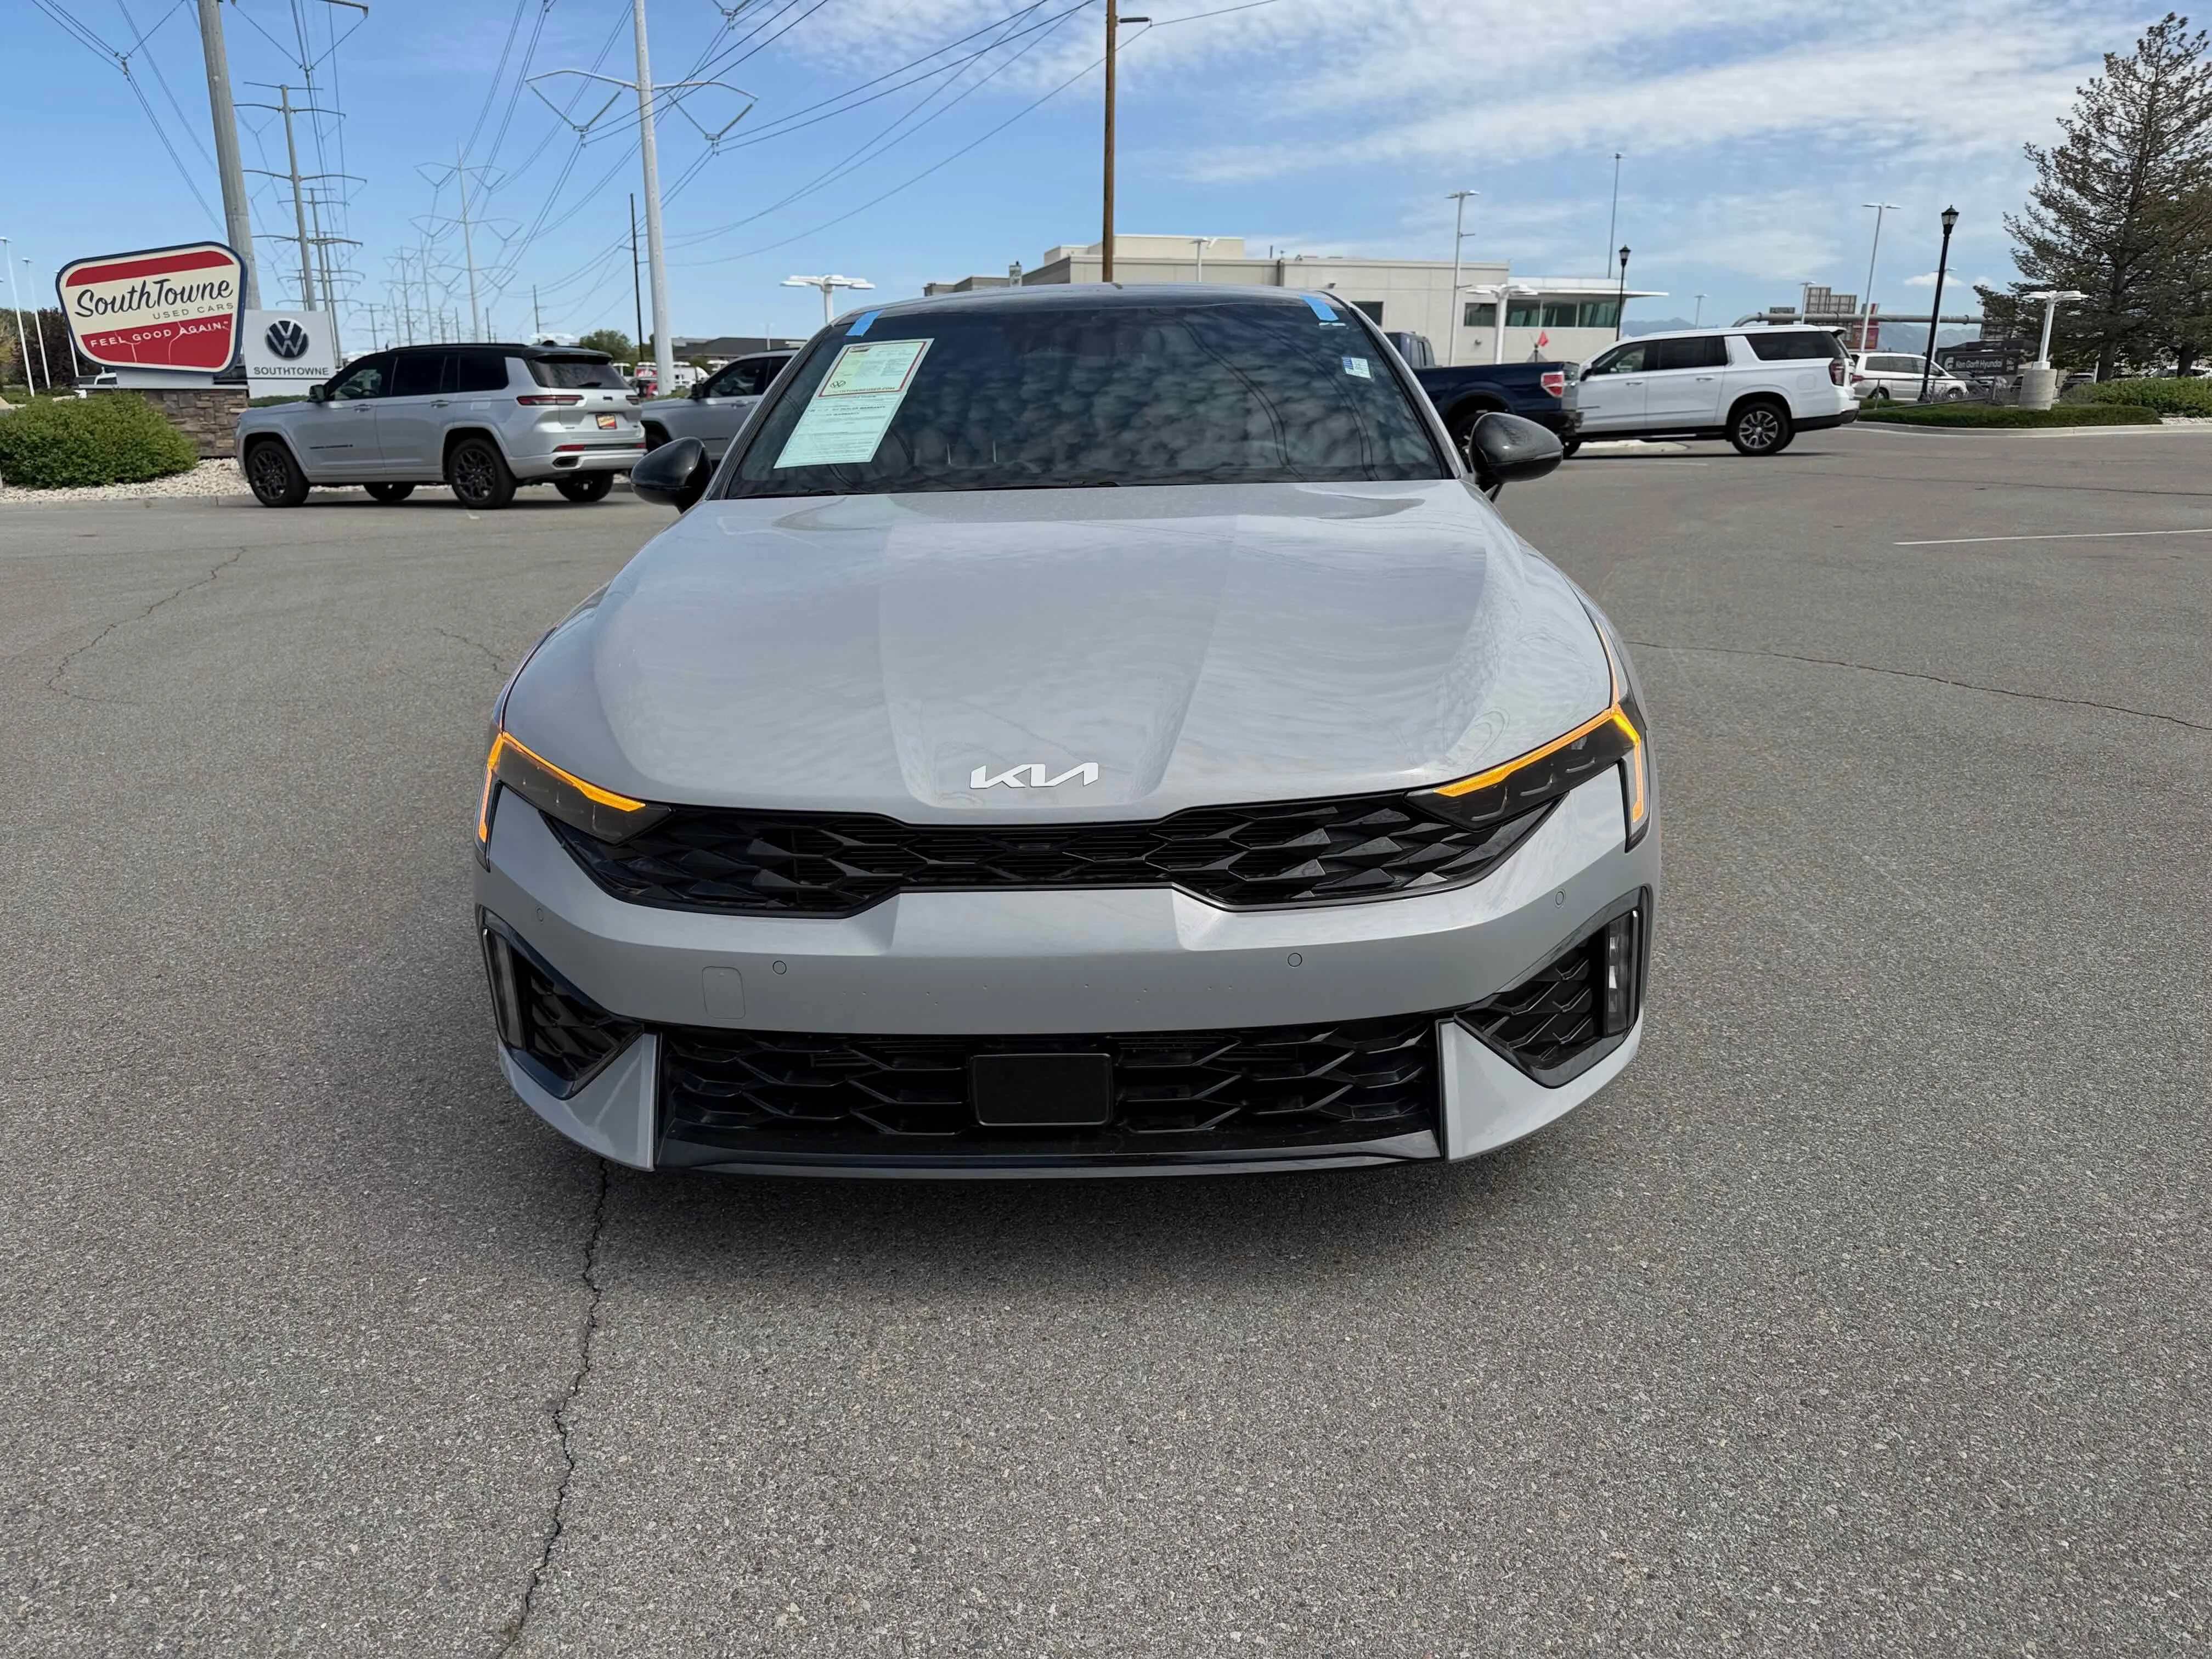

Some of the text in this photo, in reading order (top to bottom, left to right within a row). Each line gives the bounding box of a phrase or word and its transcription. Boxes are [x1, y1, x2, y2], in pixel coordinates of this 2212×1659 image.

[75, 279, 233, 318] SouthTowne
[153, 302, 234, 320] USED CARS
[90, 336, 126, 348] FEEL
[132, 329, 172, 342] GOOD
[253, 366, 329, 375] SOUTHTOWNE
[1979, 359, 2002, 369] Hyundai
[969, 762, 1098, 789] KIA
